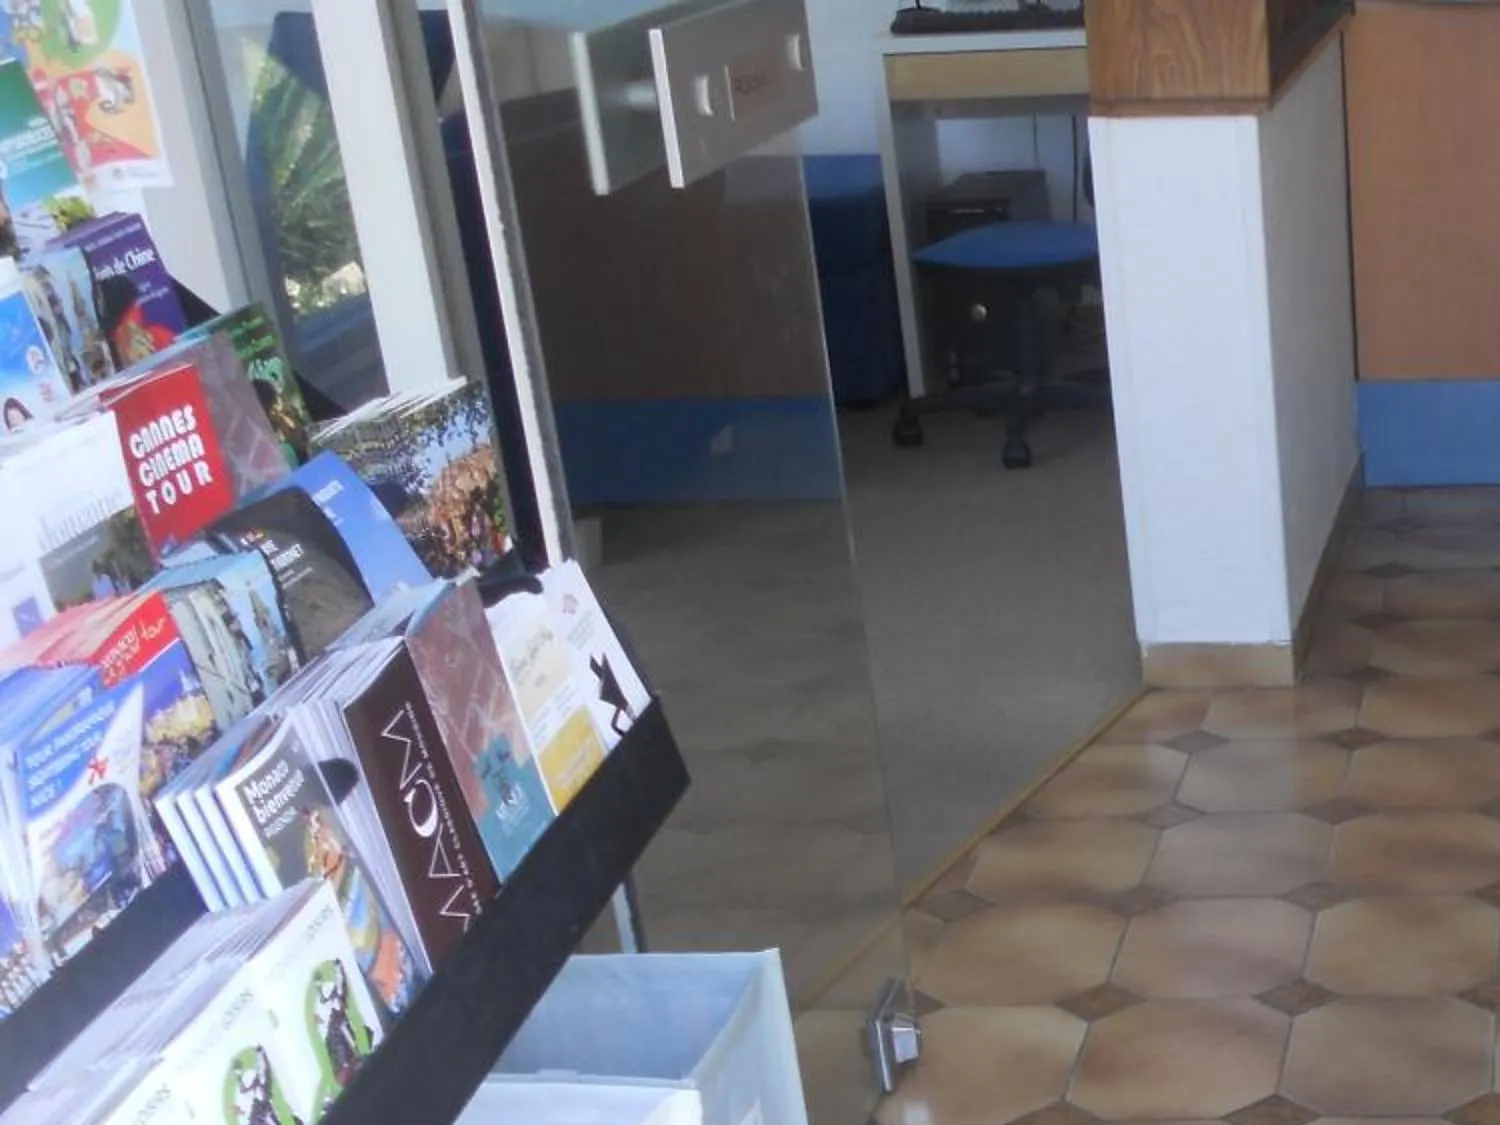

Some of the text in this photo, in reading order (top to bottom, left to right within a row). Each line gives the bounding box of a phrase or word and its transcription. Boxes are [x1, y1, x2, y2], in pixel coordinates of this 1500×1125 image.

[129, 403, 197, 459] CANNES
[139, 433, 204, 487] CINEMA
[145, 461, 214, 515] TOUR
